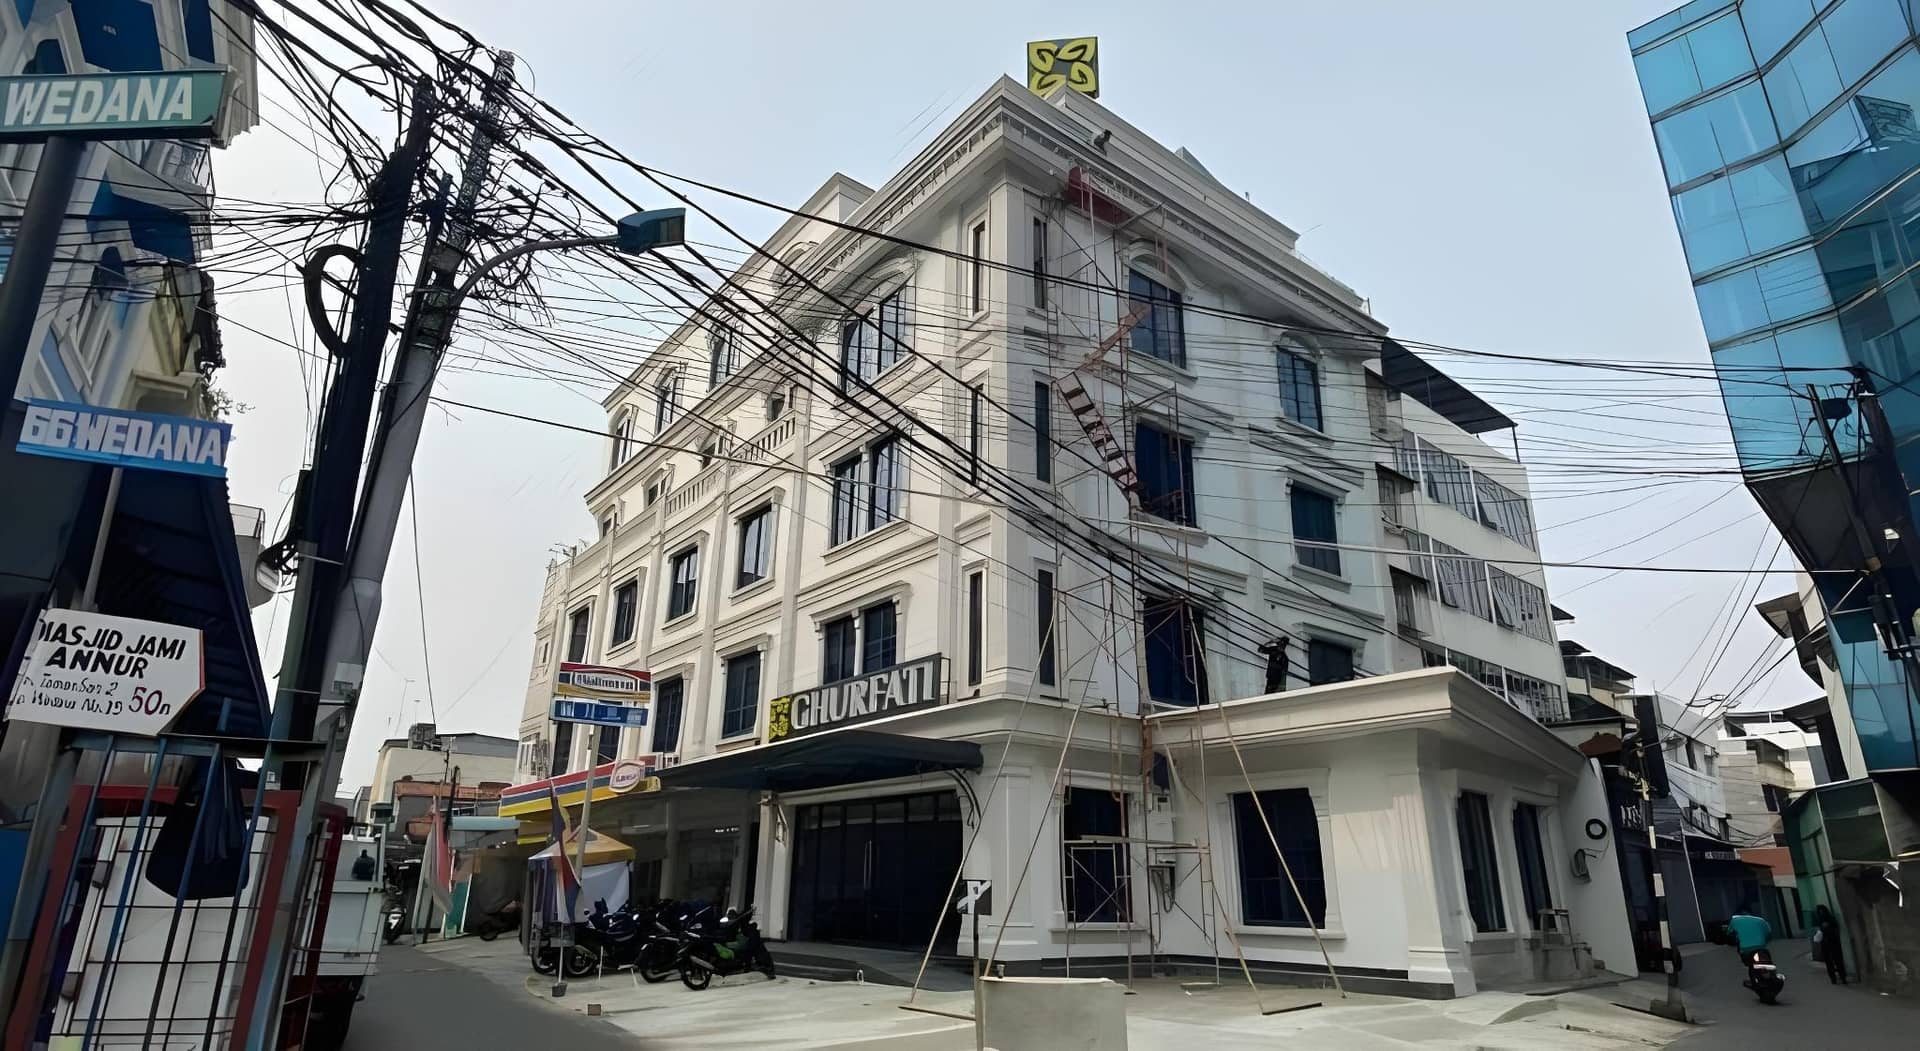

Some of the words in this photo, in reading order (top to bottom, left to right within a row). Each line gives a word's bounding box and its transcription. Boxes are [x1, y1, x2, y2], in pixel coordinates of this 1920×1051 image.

[4, 77, 192, 126] WEDANA
[45, 646, 148, 679] ANNUR
[126, 635, 186, 660] JAMI
[790, 661, 936, 730] GHURFATI
